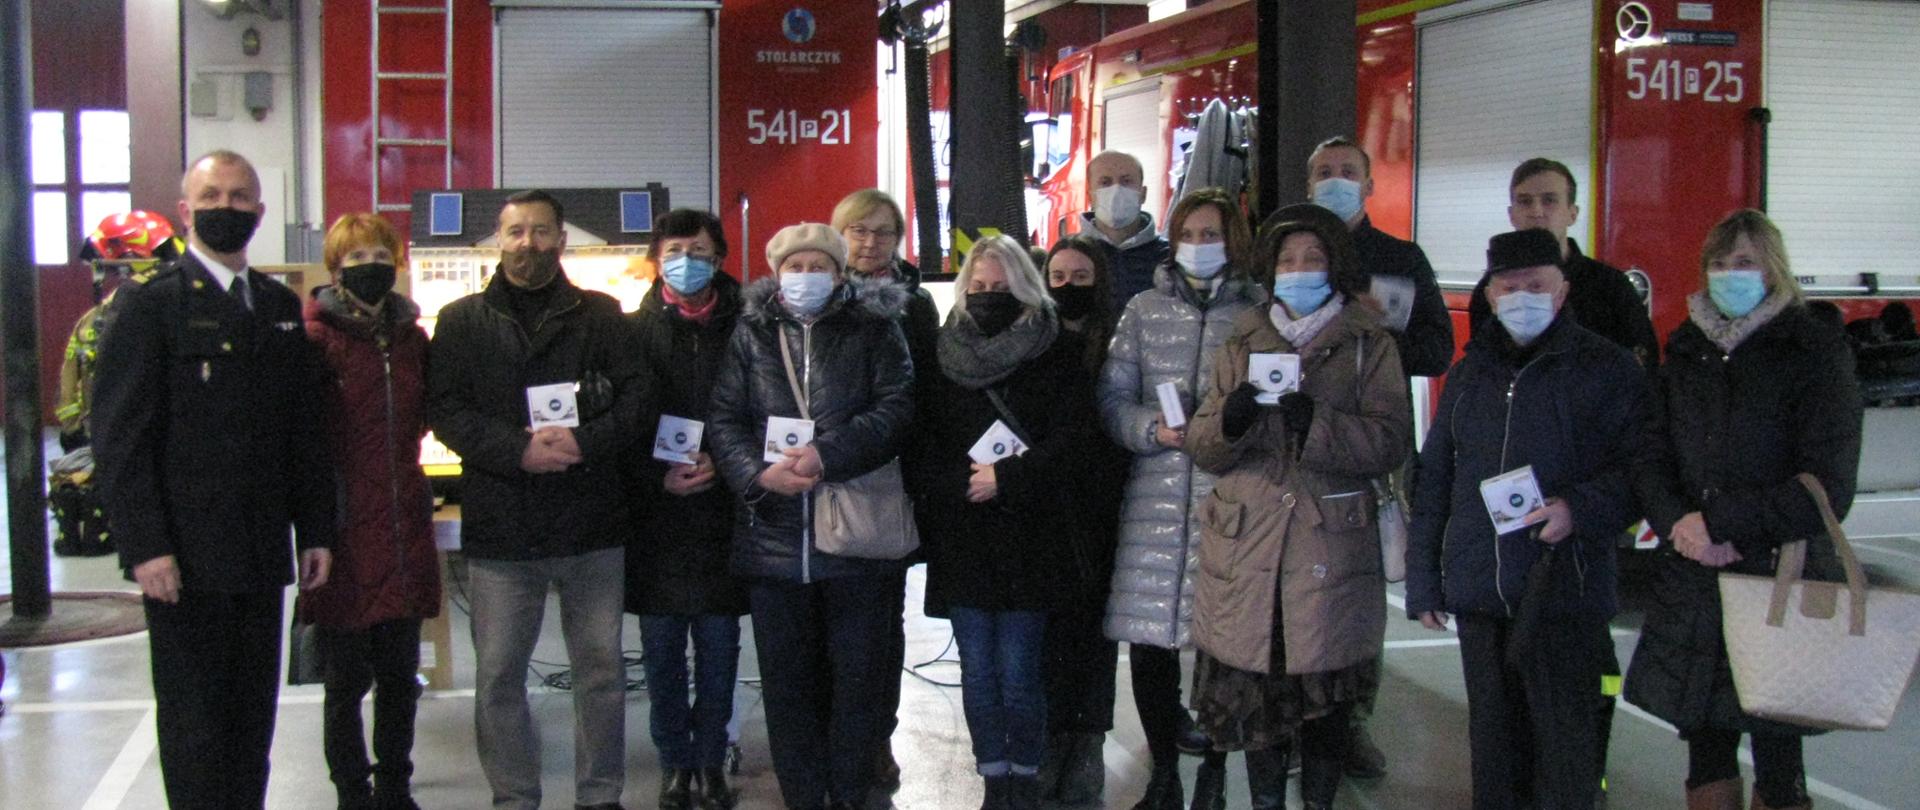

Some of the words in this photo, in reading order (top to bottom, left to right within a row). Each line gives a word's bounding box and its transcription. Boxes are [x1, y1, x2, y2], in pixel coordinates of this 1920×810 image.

[757, 51, 841, 64] STOLARCZYK
[1626, 59, 1680, 100] 541
[1703, 61, 1743, 102] 25
[748, 109, 797, 144] 541
[821, 109, 850, 144] 21
